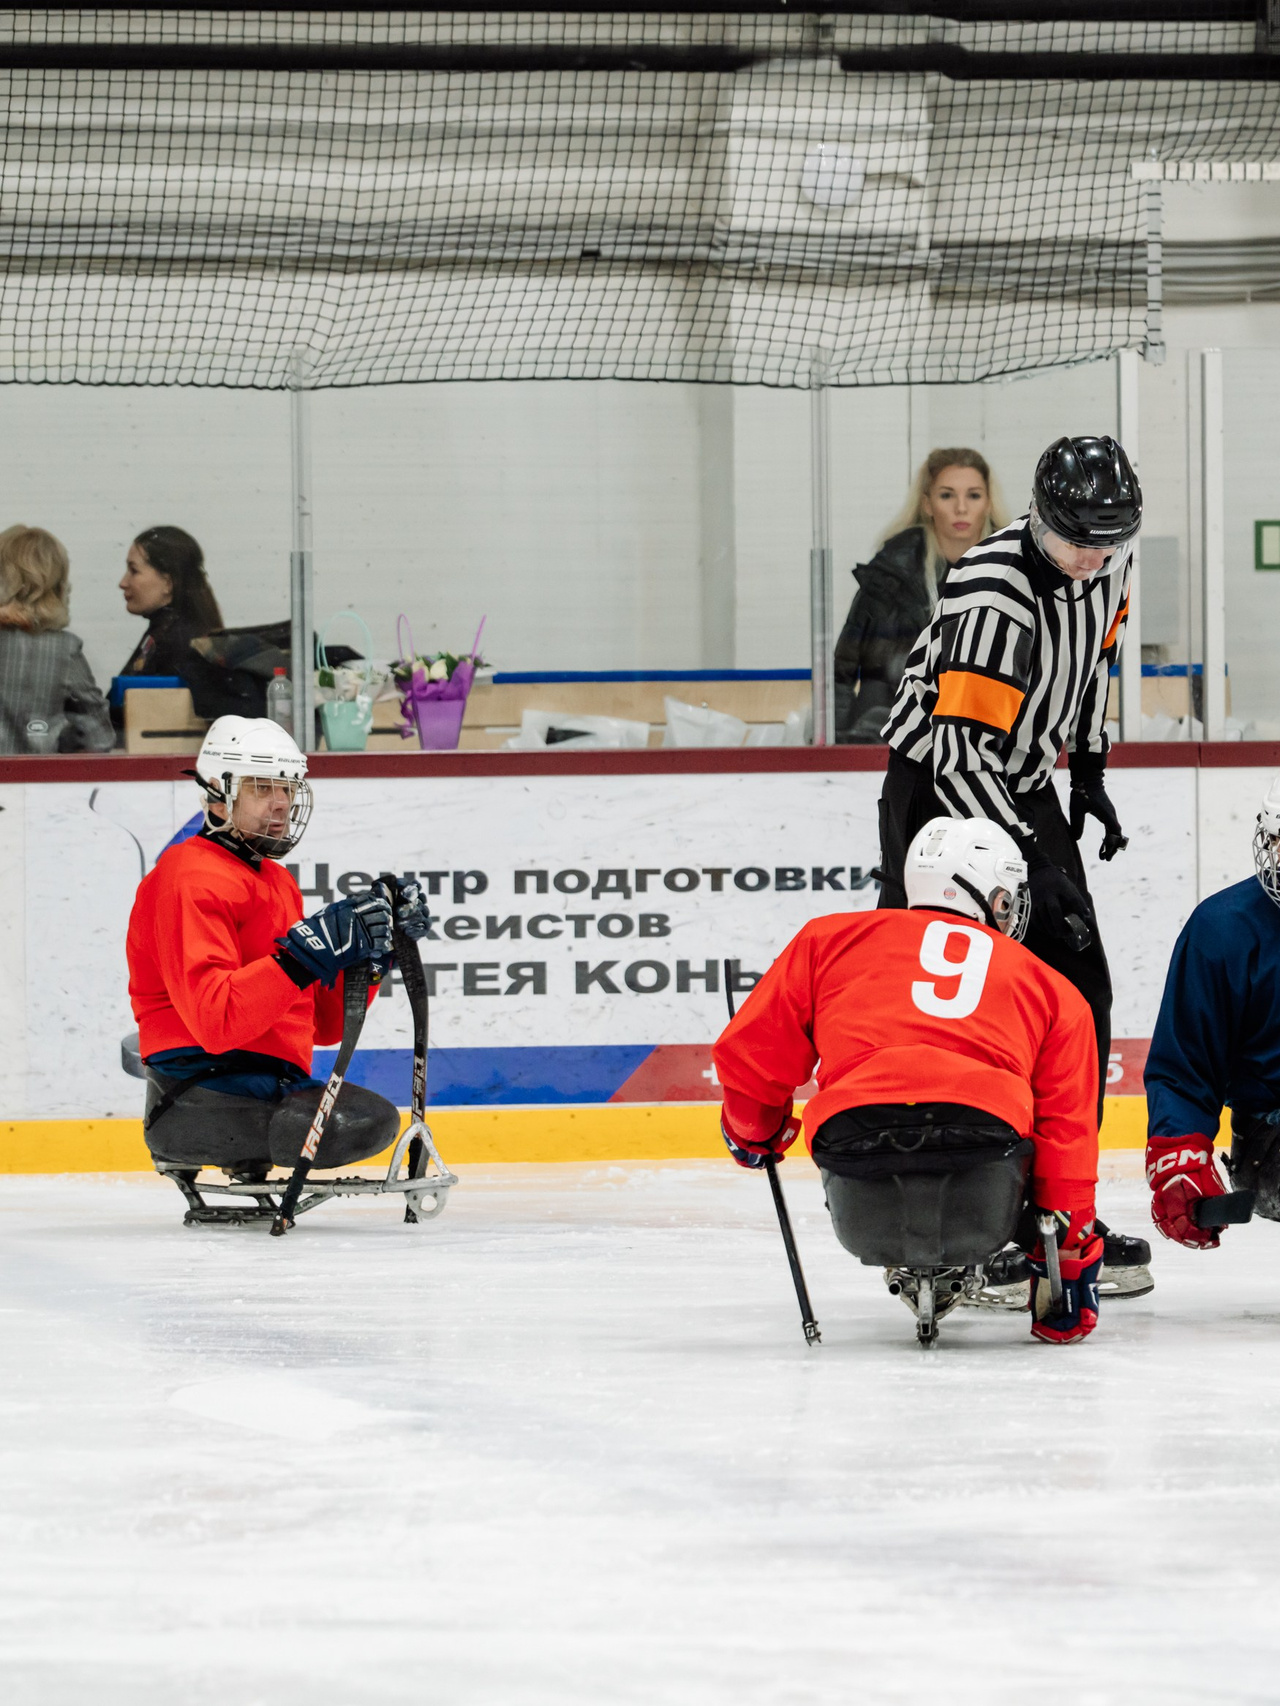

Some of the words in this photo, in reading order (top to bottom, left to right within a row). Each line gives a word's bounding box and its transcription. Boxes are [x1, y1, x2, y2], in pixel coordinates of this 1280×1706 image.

[514, 866, 882, 901] подготовки
[911, 920, 994, 1019] 9
[1146, 1148, 1208, 1184] CCM
